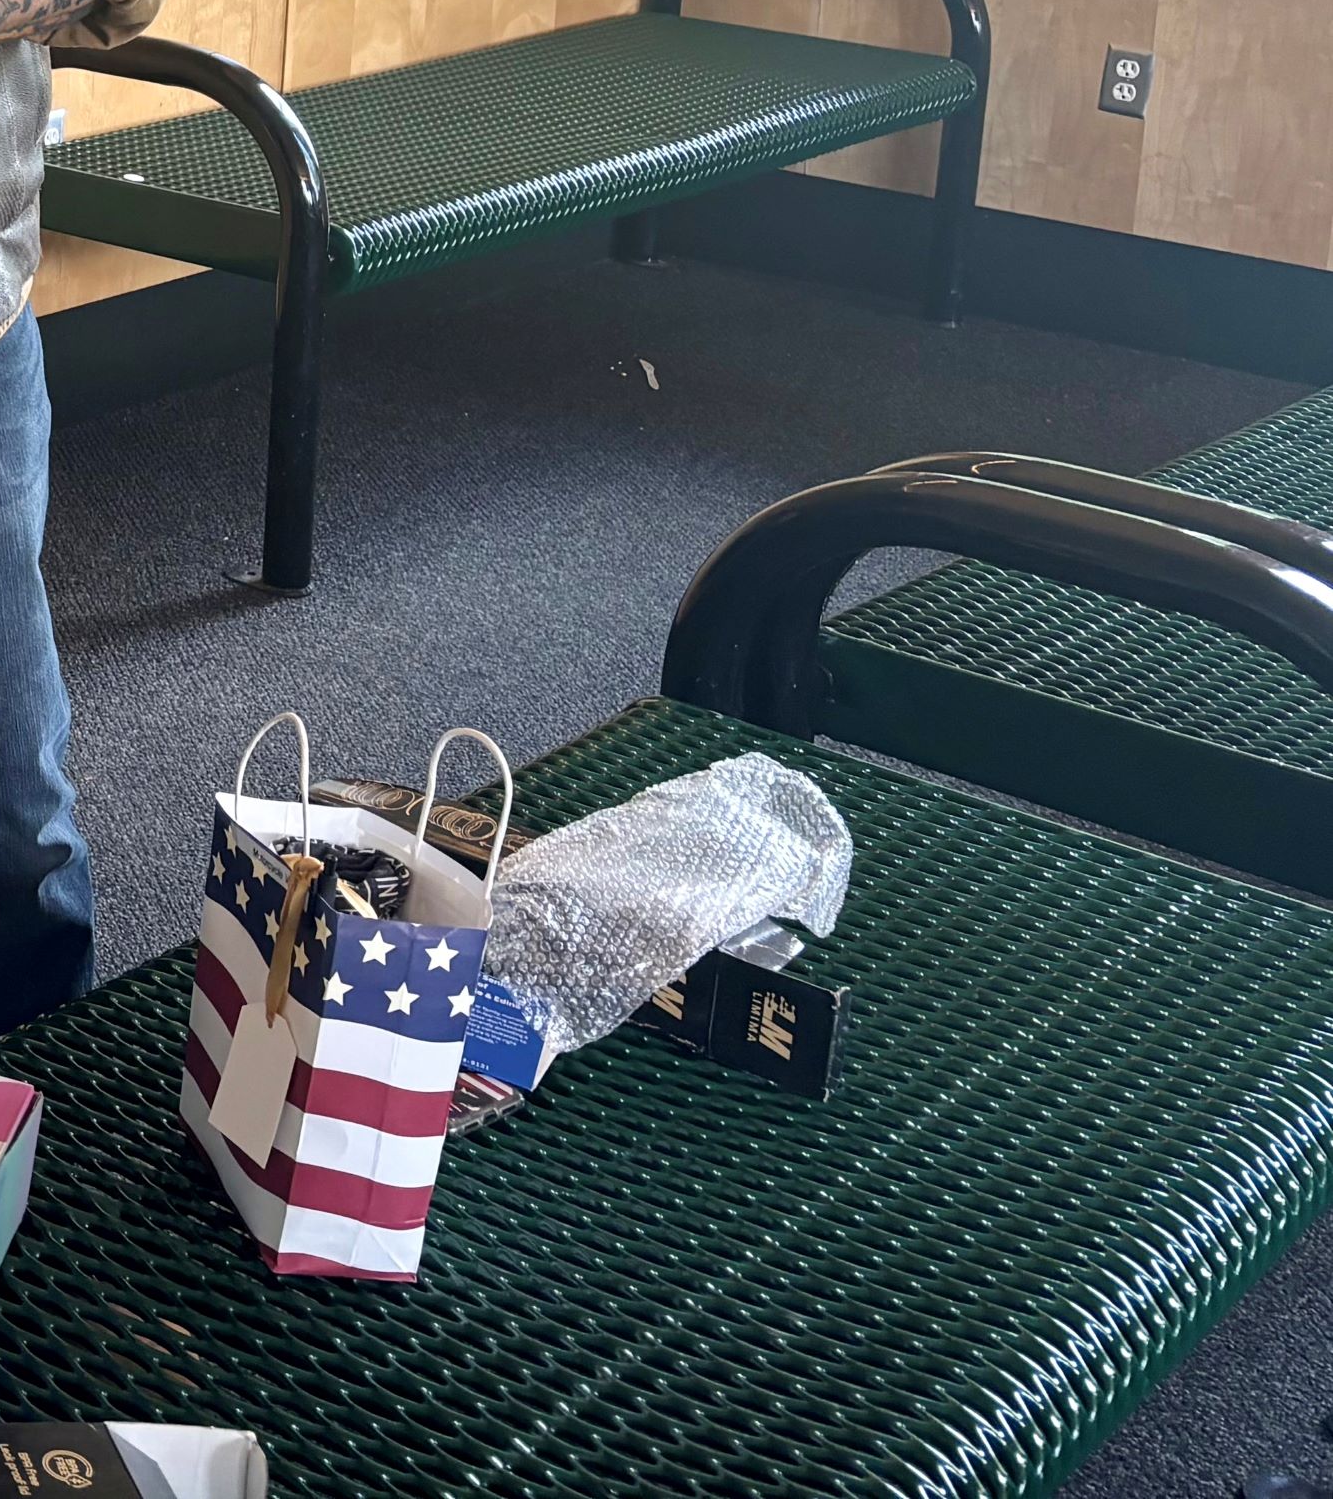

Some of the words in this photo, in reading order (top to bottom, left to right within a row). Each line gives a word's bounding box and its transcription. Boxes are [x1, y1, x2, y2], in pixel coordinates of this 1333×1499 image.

[747, 991, 763, 1042] LIMIMA
[18, 1452, 30, 1468] BPA
[55, 1456, 69, 1477] FREE
[66, 1458, 79, 1475] BPA
[9, 1462, 27, 1485] proof
